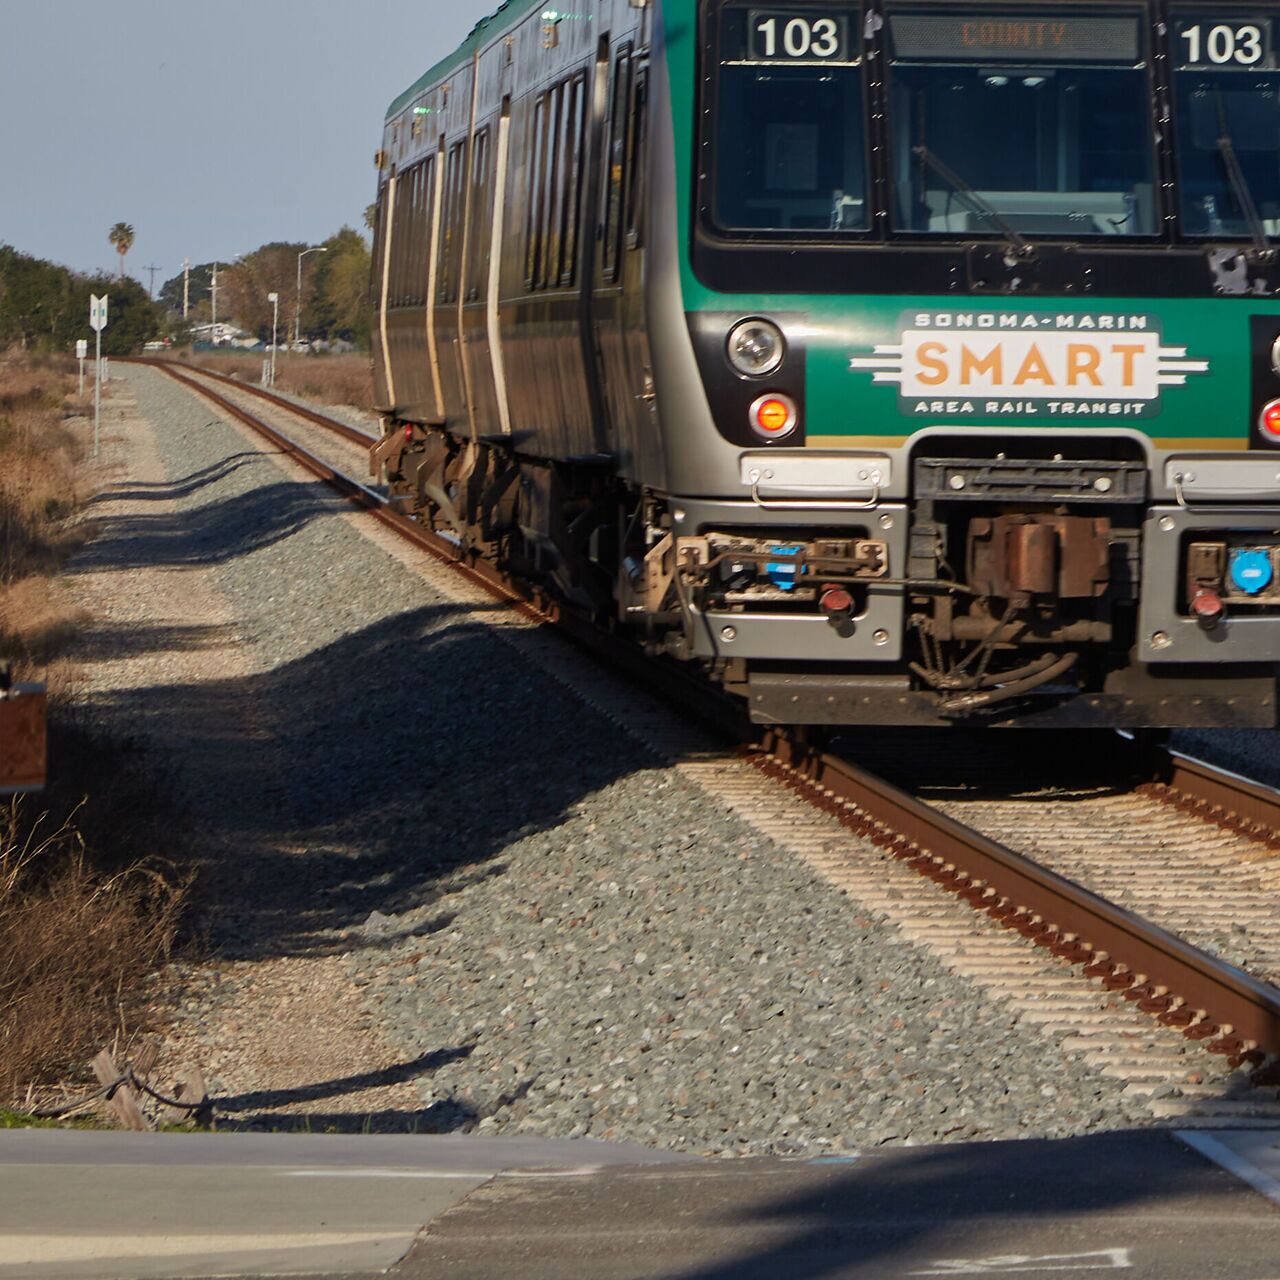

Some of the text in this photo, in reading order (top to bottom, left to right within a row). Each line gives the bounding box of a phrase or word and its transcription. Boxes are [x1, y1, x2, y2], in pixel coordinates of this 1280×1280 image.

[757, 18, 839, 58] 103
[962, 22, 1067, 47] COUNTY
[1181, 25, 1263, 65] 103
[915, 341, 1145, 387] SMART
[914, 400, 1146, 415] AREA RAIL TRANSIT
